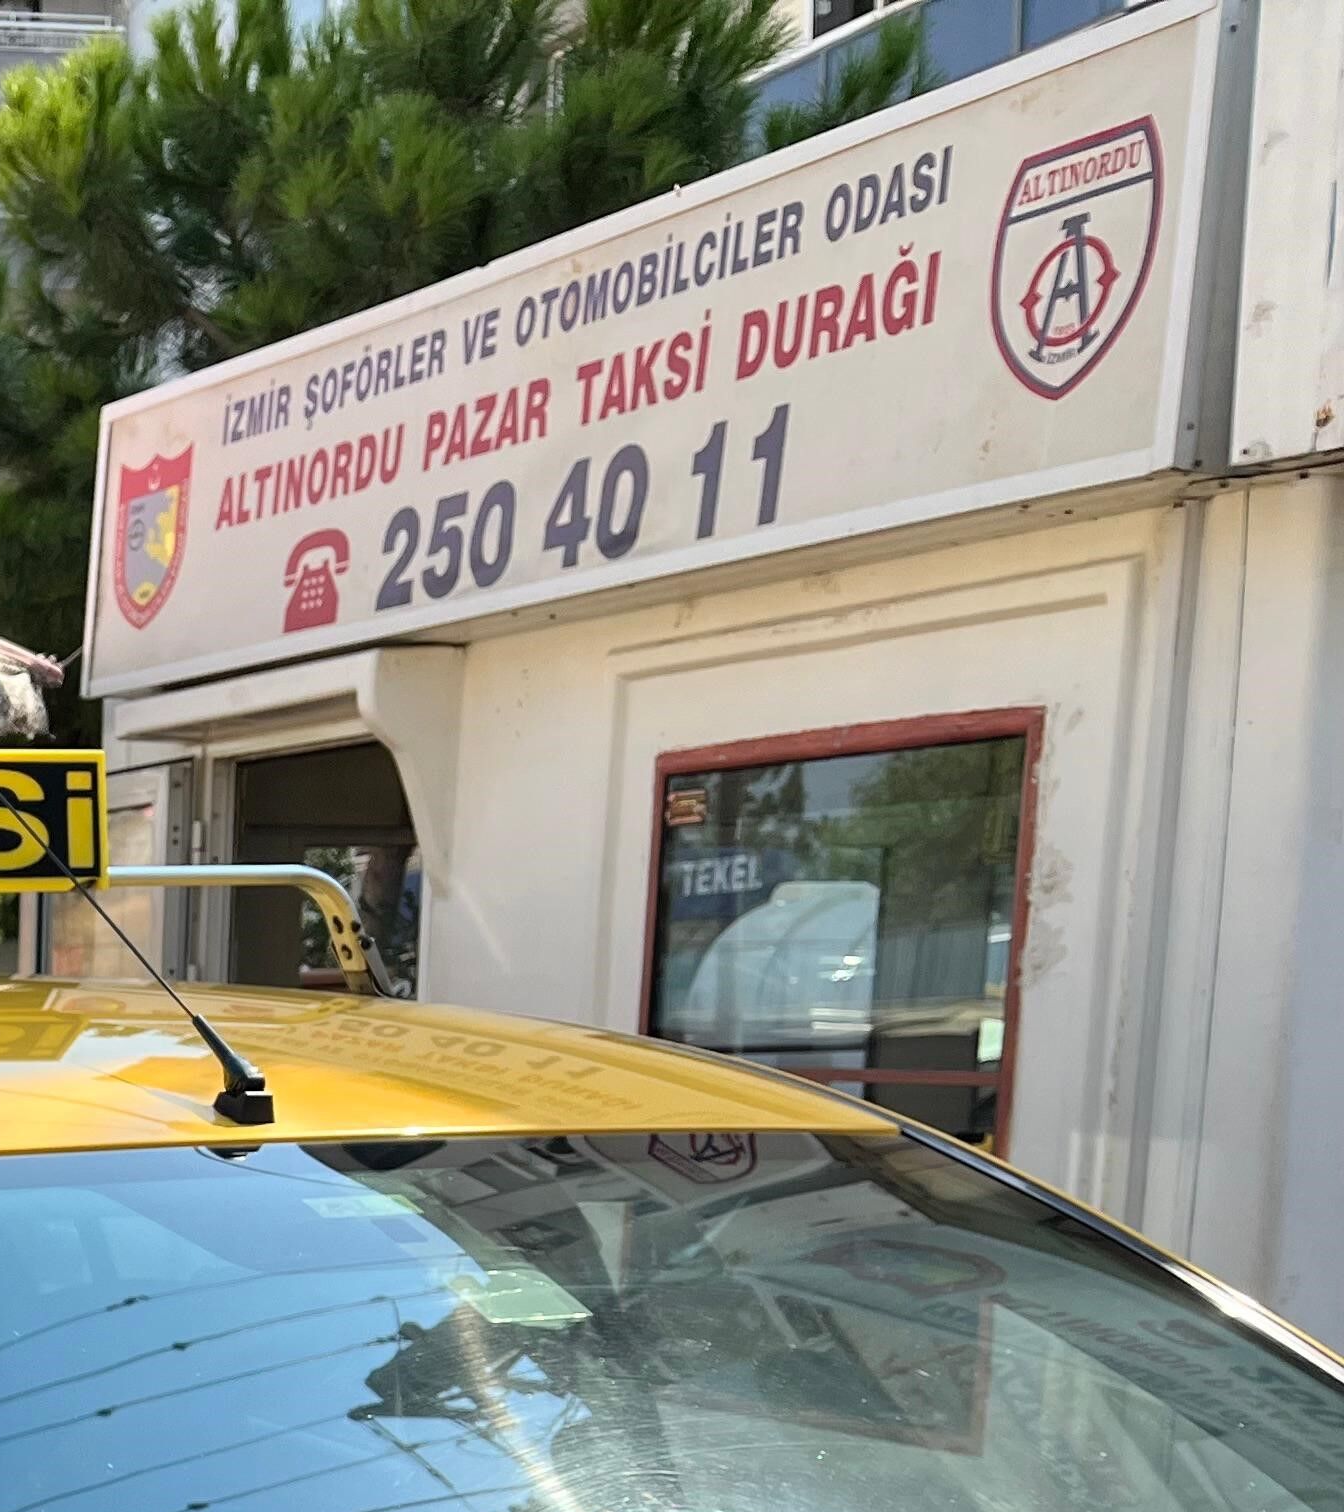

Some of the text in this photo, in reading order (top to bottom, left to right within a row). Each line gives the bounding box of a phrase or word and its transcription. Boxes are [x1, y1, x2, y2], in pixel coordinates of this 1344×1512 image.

[1018, 138, 1145, 206] ALTINORDU
[215, 242, 941, 530] ALTINORDU PAZAR TAKSİ DURAĞI
[222, 145, 953, 445] İZMİR ŞOFÖRLER VE OTOMOBİLCİLER ODASI
[375, 403, 790, 611] 250 40 11
[679, 854, 762, 897] TEKEL
